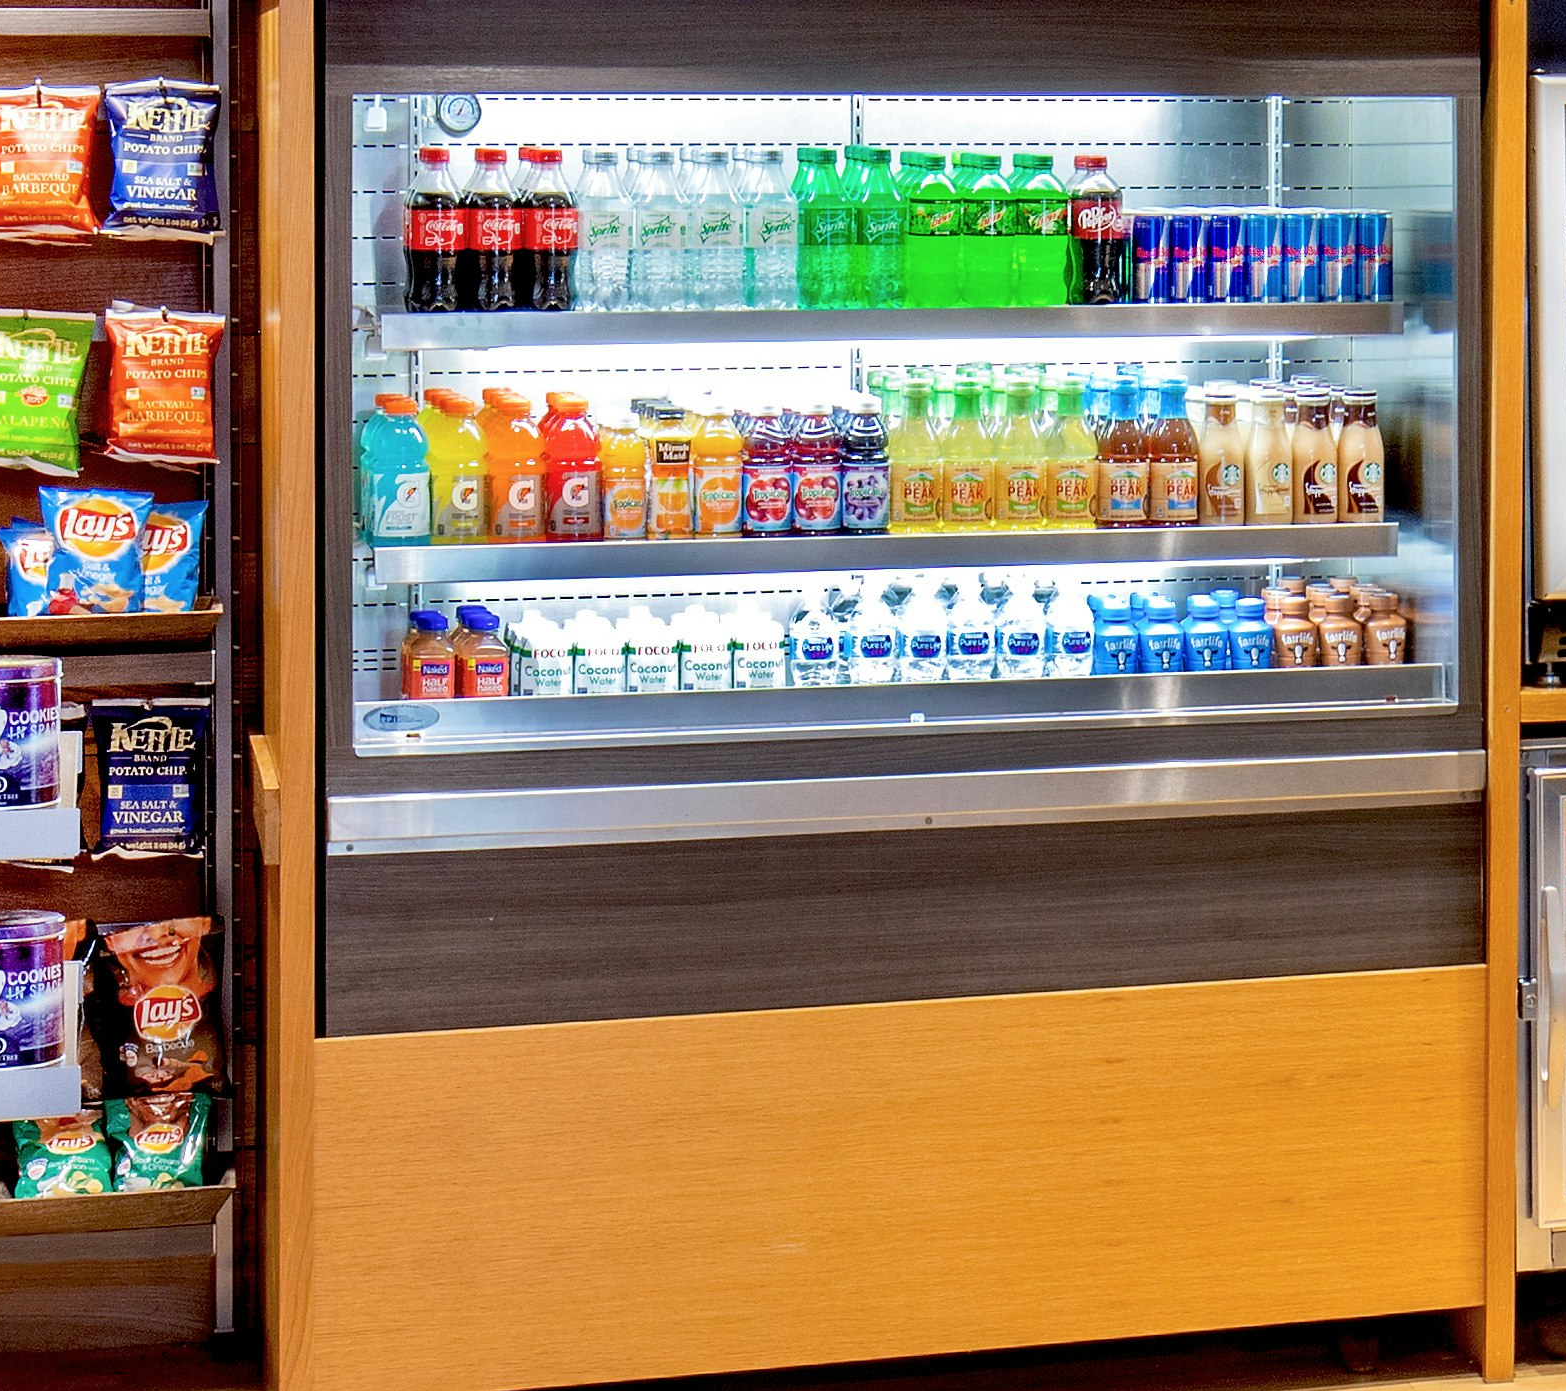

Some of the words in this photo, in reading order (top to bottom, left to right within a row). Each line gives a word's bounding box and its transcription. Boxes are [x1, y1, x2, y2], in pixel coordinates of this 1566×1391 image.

[123, 97, 211, 131] KETTLE
[150, 133, 183, 142] BRAND
[1, 143, 45, 154] POTATO
[50, 143, 85, 155] CHIPS
[124, 143, 169, 155] POTATO
[12, 172, 69, 183] BACKYARD
[134, 176, 153, 185] SEA
[156, 176, 180, 186] SALT
[183, 175, 191, 185] &
[127, 185, 197, 201] VINEGAR
[589, 223, 619, 241] Sprite
[641, 224, 670, 237] Sprite
[700, 221, 731, 237] Sprite
[122, 325, 209, 358] KETTLE
[43, 374, 79, 386] CHIPS
[125, 369, 170, 380] POTATO
[174, 369, 208, 380] CHIPS
[138, 398, 194, 409] BACKYARD
[125, 409, 206, 424] BARBEQUE
[950, 488, 984, 500] PEAK
[1006, 486, 1040, 497] PEAK
[1055, 486, 1089, 497] PEAK
[1109, 486, 1143, 497] PEAK
[62, 507, 132, 545] Lay's
[1281, 631, 1314, 645] fairlife
[1324, 630, 1358, 644] fairlife
[1376, 626, 1407, 641] fairlife
[1105, 637, 1137, 652] fairlife
[1148, 638, 1182, 651] fairlife
[1190, 636, 1224, 649] fairlife
[1237, 636, 1270, 649] fairlife
[534, 648, 566, 659] FOCO
[589, 676, 616, 686] Water
[639, 674, 667, 685] Water
[695, 672, 723, 682] Water
[748, 670, 775, 680] Water
[535, 678, 563, 688] Water
[107, 716, 196, 754] KETTLE
[134, 755, 167, 763] BRAND
[109, 766, 151, 776] POTATO
[120, 801, 138, 811] SEA
[141, 800, 165, 811] SALT
[168, 799, 178, 810] &
[113, 811, 185, 825] VINEGAR
[140, 996, 195, 1025] Lay's
